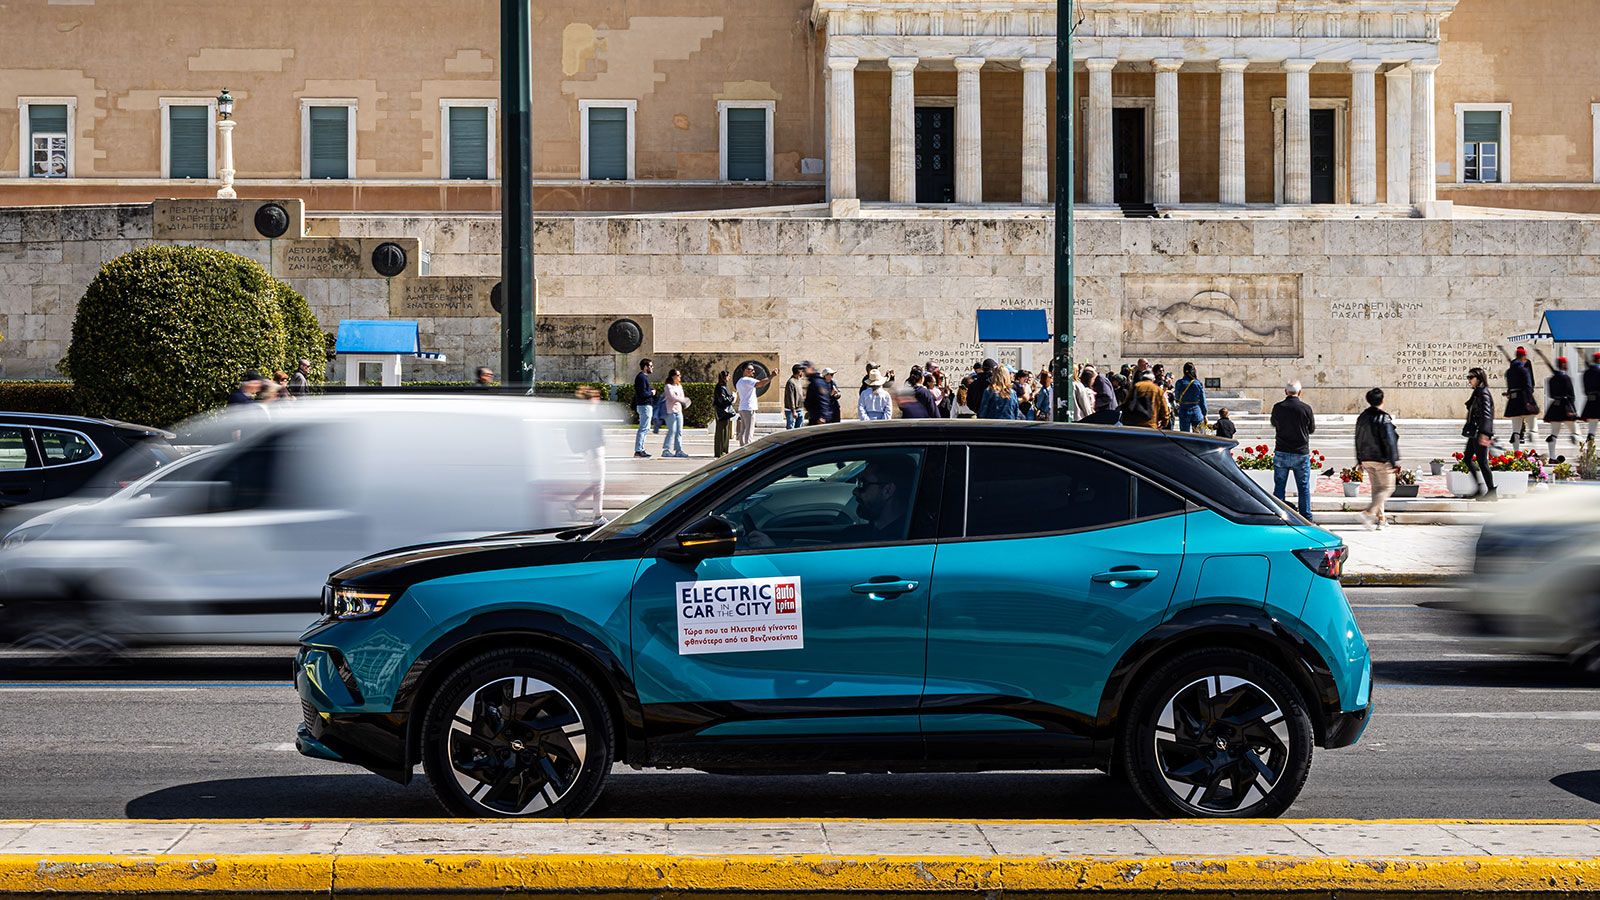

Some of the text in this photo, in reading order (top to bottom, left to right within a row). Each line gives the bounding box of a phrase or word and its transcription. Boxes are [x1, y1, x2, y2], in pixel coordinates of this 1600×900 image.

[682, 585, 771, 603] ELECTRIC
[683, 605, 715, 618] CAR
[735, 601, 771, 616] CITY
[684, 628, 703, 637] Τώρα
[768, 624, 798, 633] γίνονται
[684, 638, 724, 647] φθηνότερα
